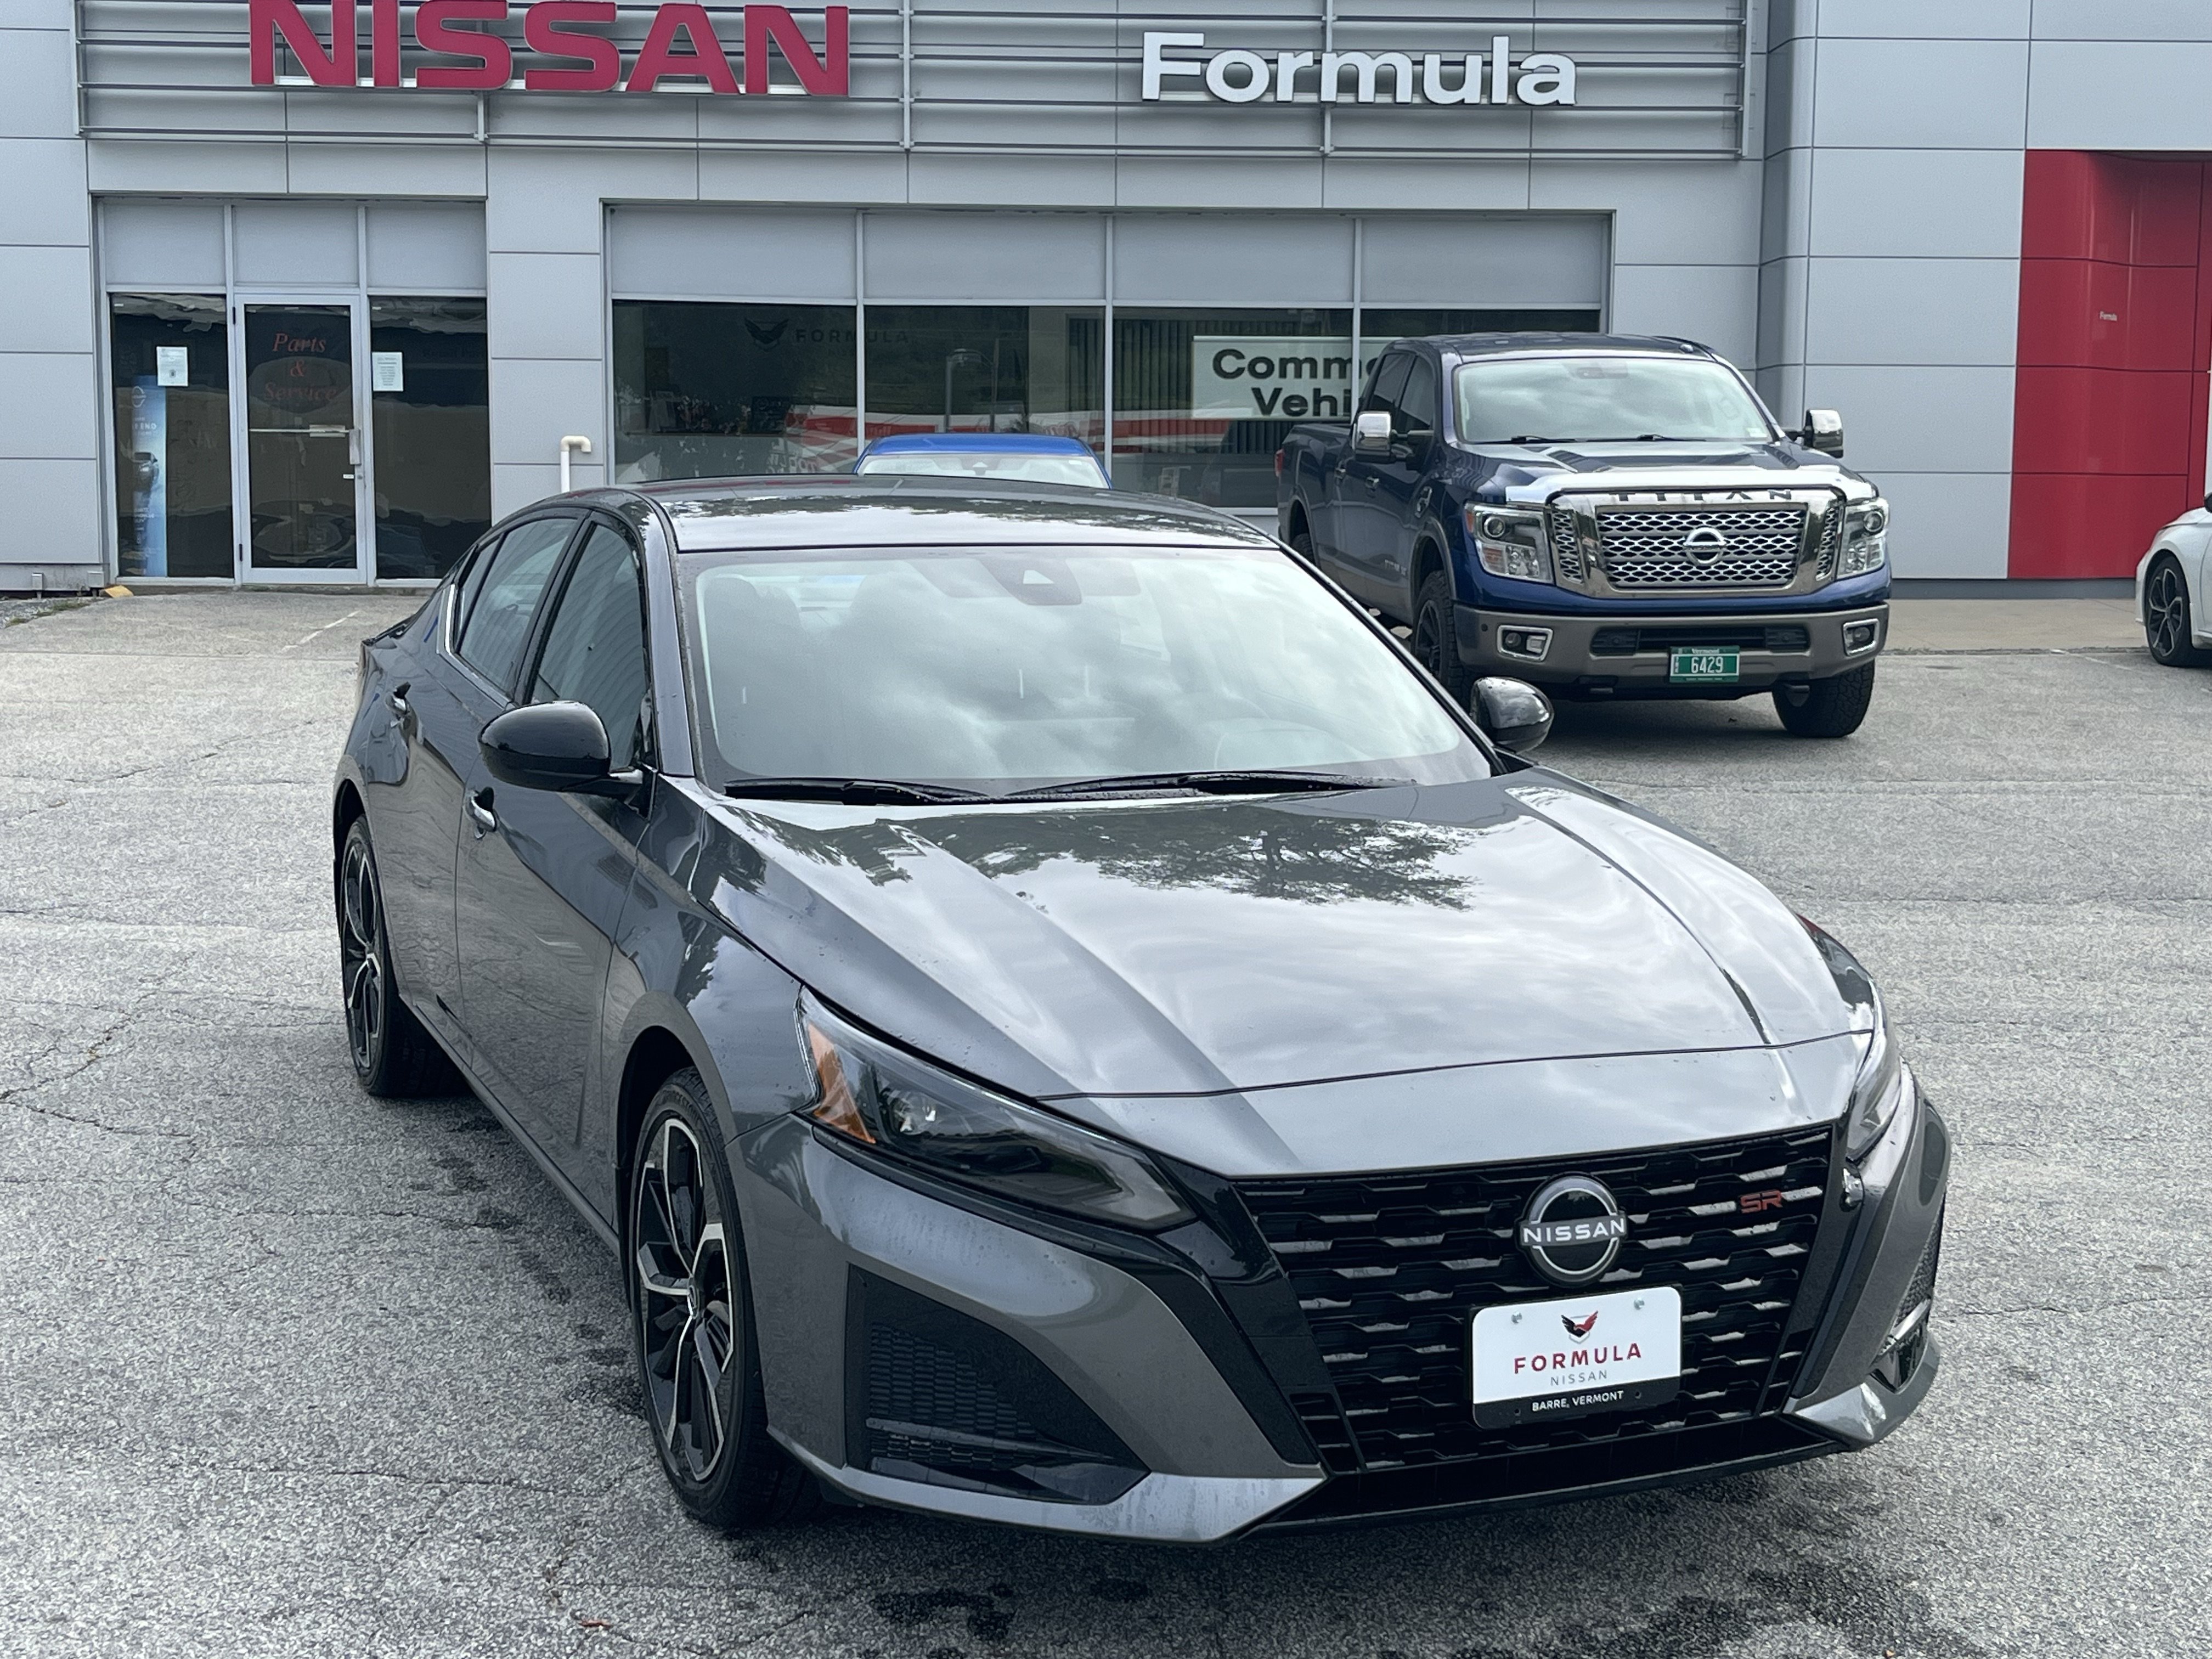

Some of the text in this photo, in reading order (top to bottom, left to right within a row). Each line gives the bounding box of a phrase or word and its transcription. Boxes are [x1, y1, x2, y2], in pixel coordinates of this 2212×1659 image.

[249, 0, 849, 97] NISSAN
[1141, 31, 1577, 105] Formula
[272, 332, 326, 352] Parts
[290, 360, 305, 377] &
[264, 382, 337, 401] Service
[1609, 489, 1792, 501] TITAN
[1691, 656, 1724, 674] 6429
[1740, 1190, 1782, 1214] SR
[1523, 1217, 1626, 1244] NISSAN
[1514, 1343, 1641, 1374] FORMULA
[1550, 1370, 1607, 1386] NISSAN
[1572, 1391, 1624, 1408] VERMONT
